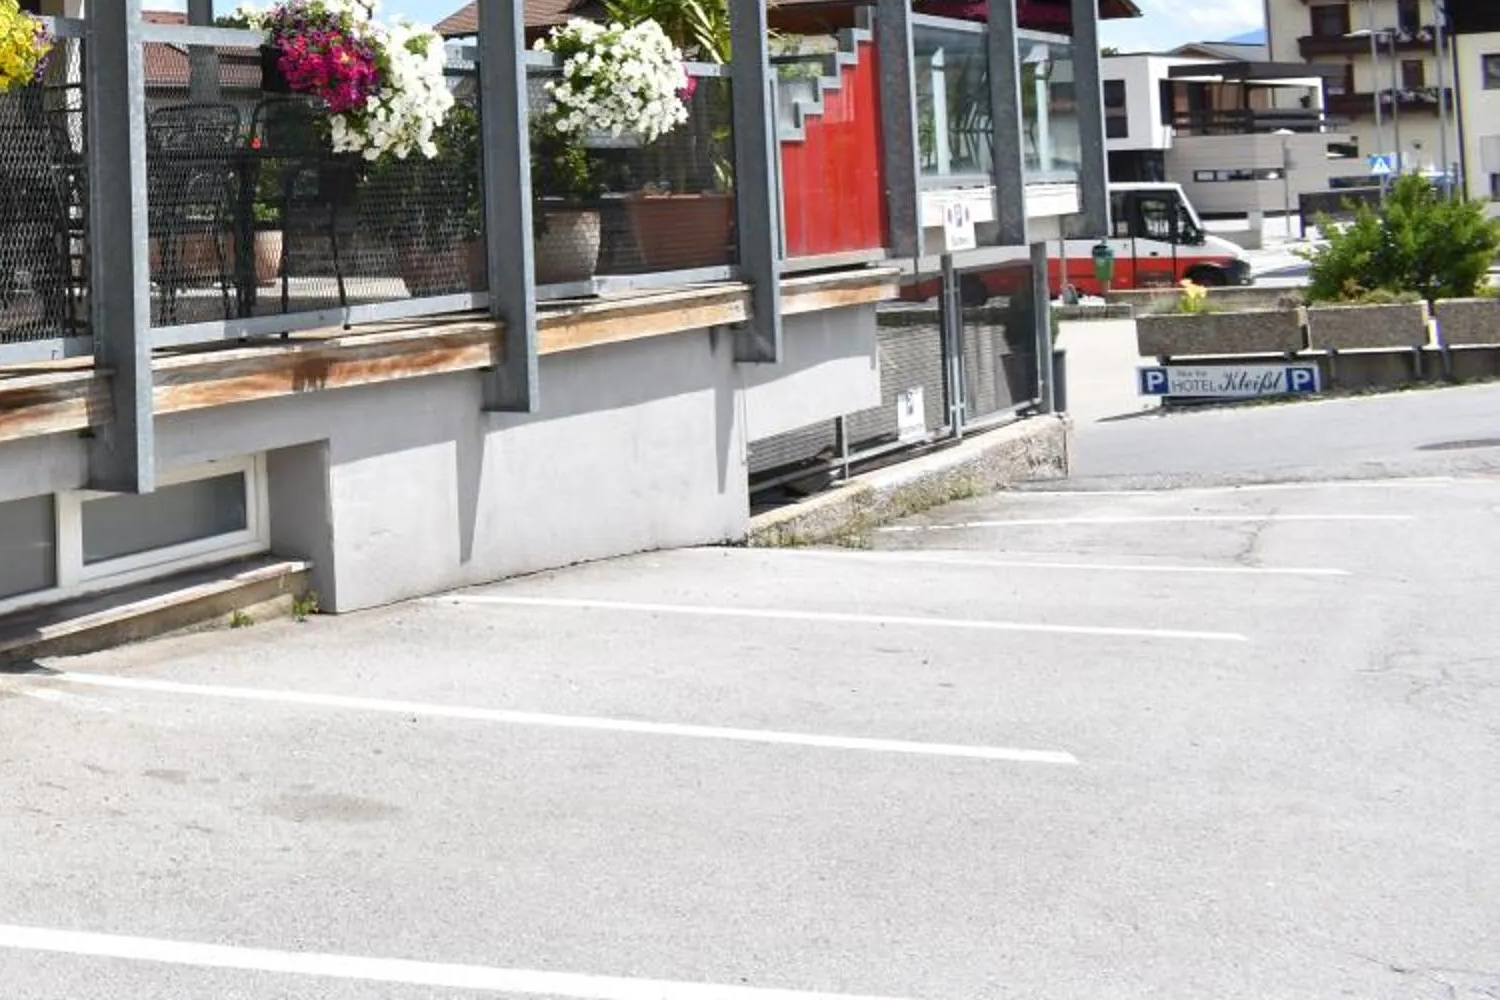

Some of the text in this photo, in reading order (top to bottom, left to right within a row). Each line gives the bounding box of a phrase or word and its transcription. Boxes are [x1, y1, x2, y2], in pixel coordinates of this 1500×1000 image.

[1147, 371, 1164, 392] P
[1172, 379, 1217, 393] HOTEL
[1292, 370, 1310, 390] P
